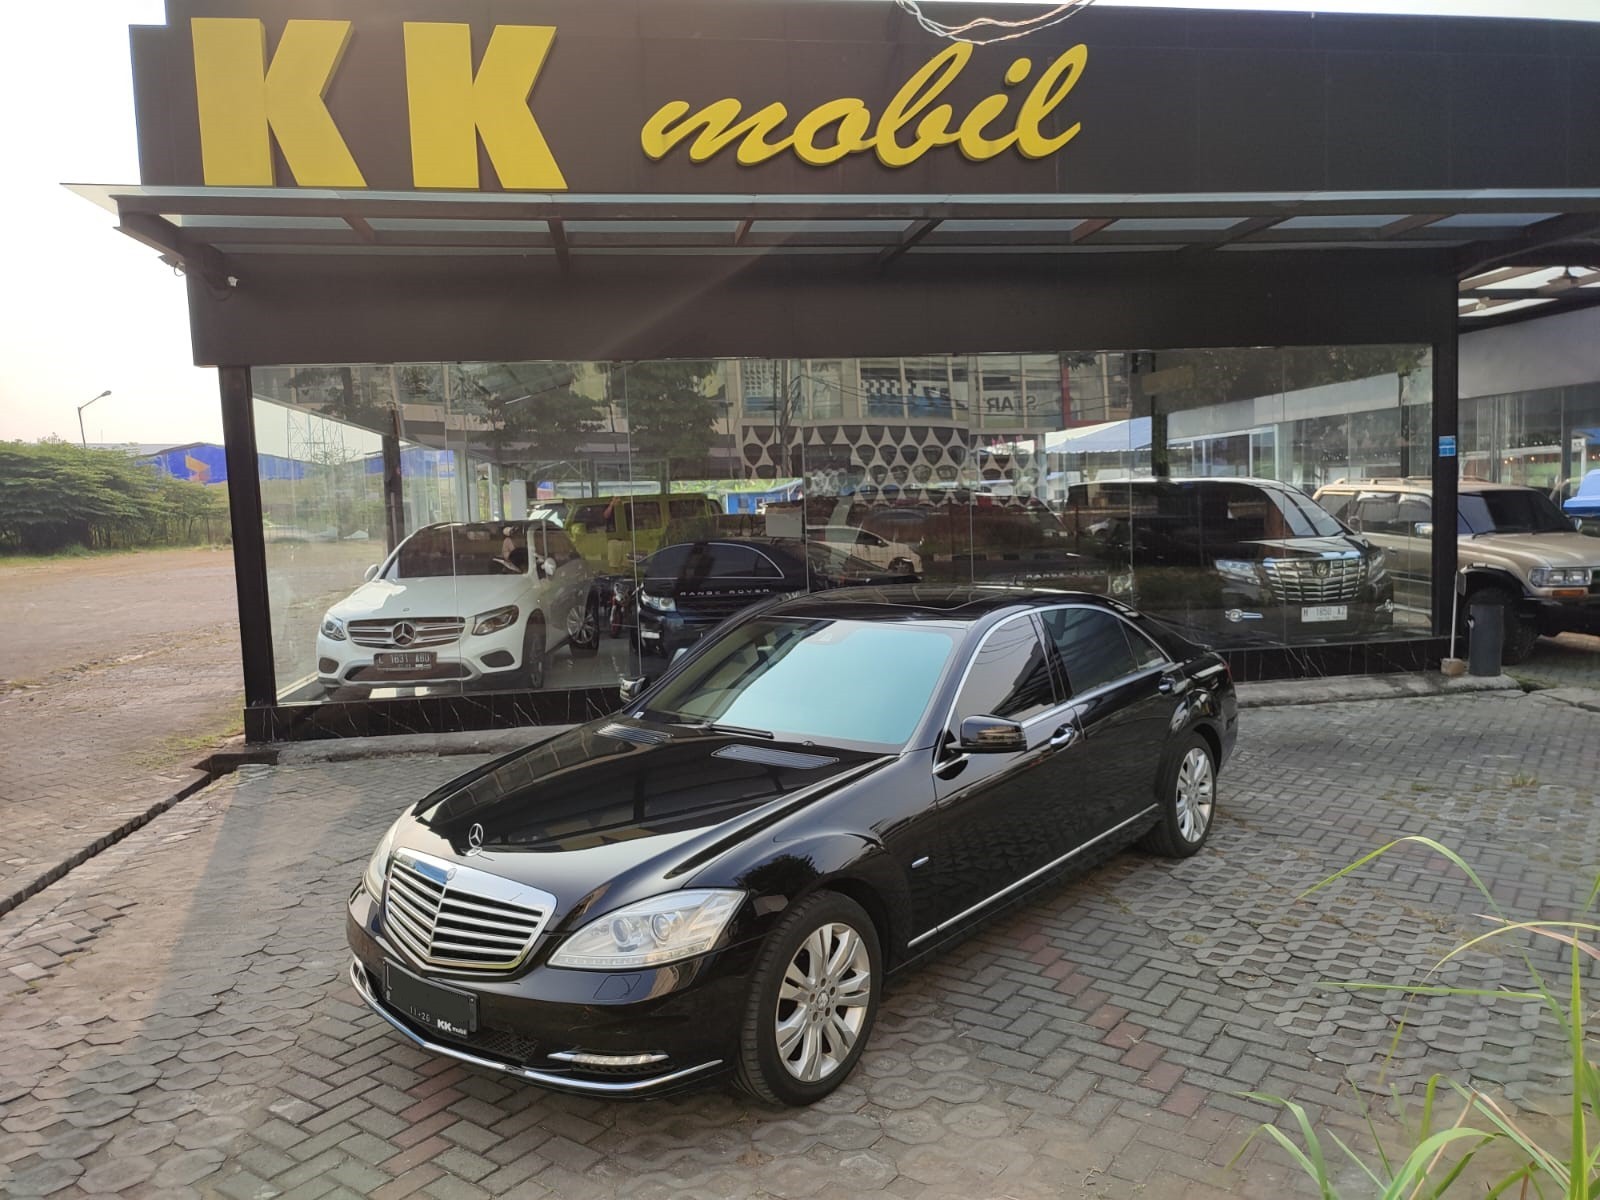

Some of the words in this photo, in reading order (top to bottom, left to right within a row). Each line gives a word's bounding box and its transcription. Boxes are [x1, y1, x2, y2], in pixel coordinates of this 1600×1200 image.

[191, 17, 568, 190] KK
[641, 41, 1088, 167] mobil
[436, 1018, 453, 1032] KK
